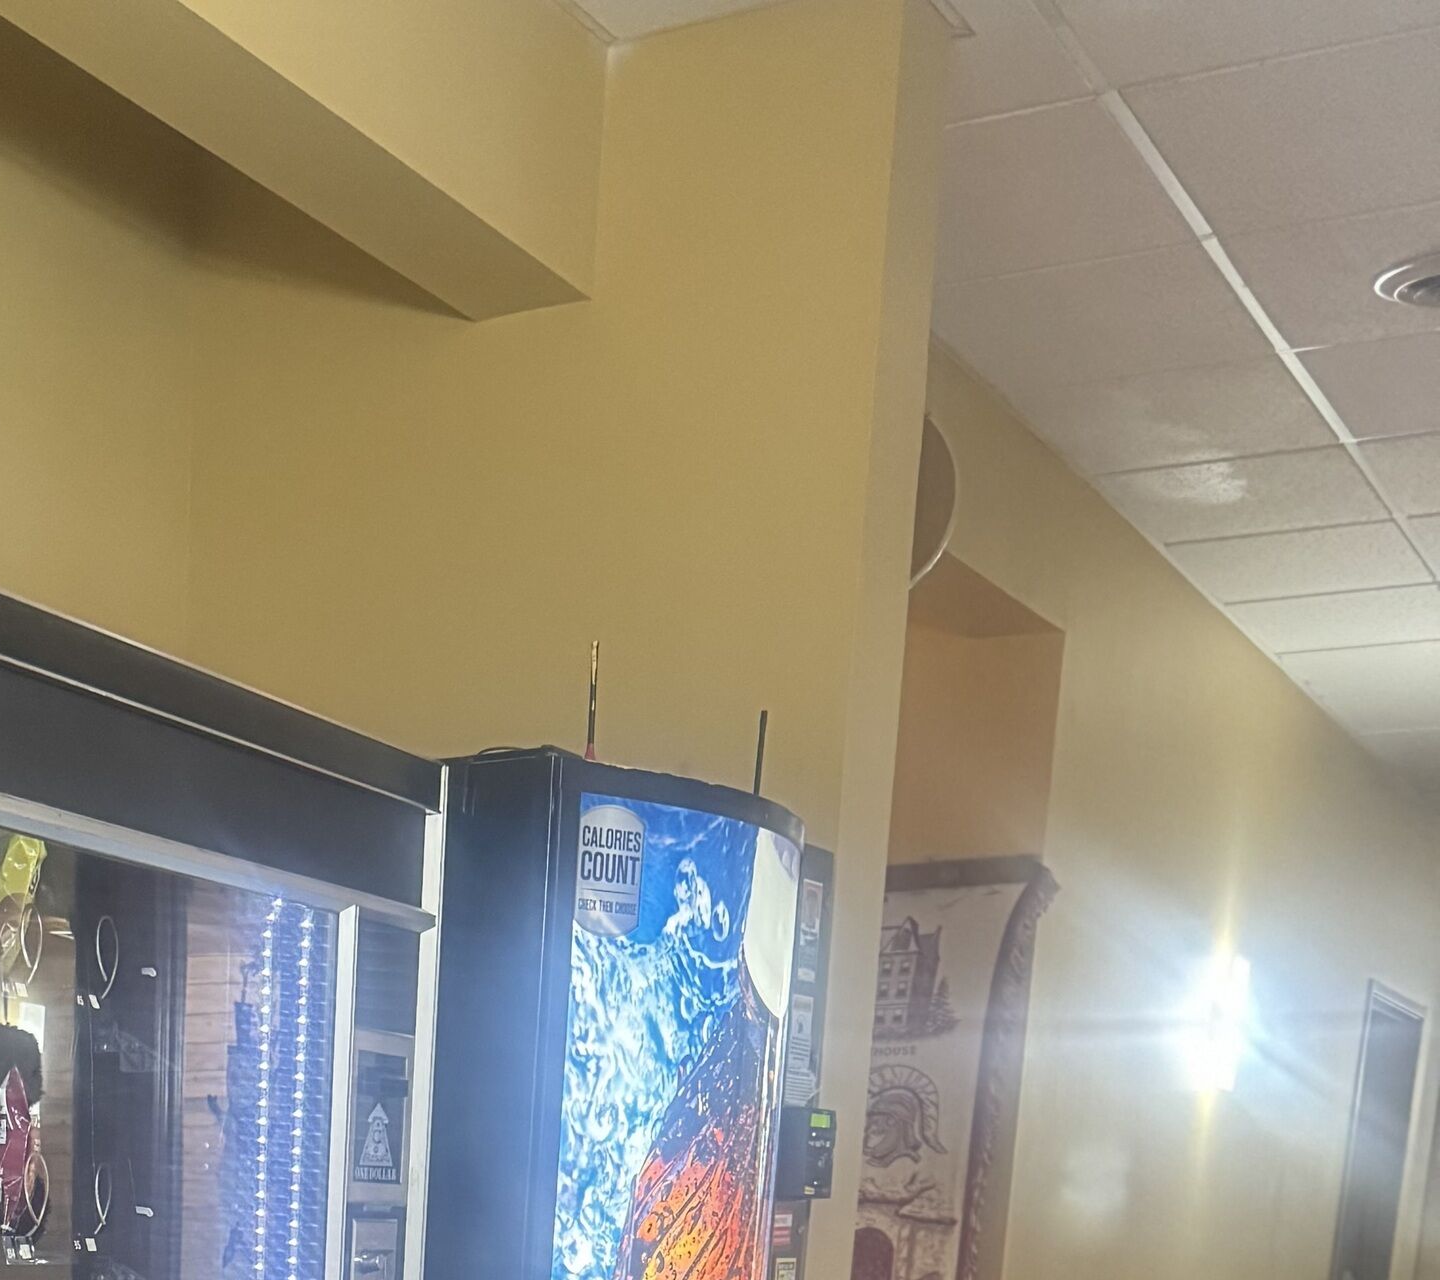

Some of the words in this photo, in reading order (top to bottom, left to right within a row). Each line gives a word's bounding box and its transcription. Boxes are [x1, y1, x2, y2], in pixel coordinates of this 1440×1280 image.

[582, 825, 642, 853] CALORIES
[580, 850, 640, 886] COUNT
[578, 897, 597, 912] CHECK
[599, 899, 614, 914] THEN
